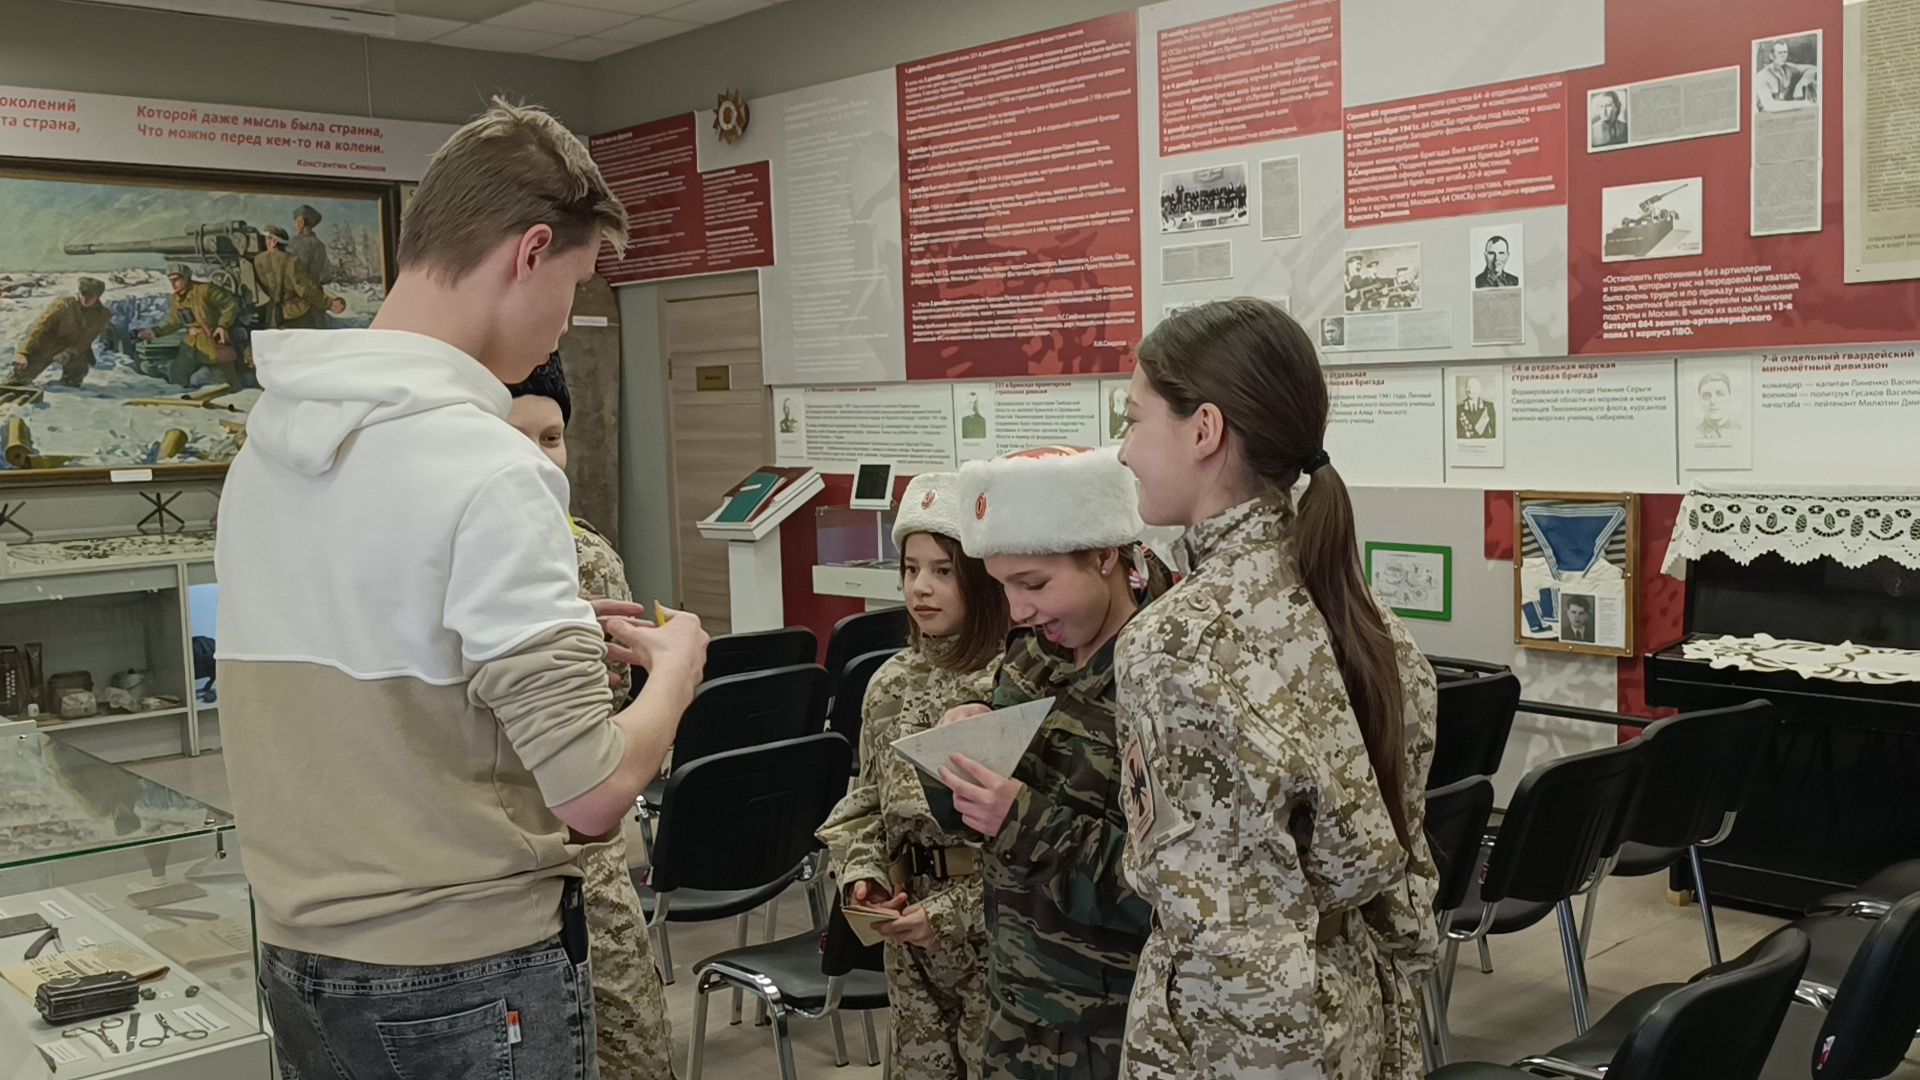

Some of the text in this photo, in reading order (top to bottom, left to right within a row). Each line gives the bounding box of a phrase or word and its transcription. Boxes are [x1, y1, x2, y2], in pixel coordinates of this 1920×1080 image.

[1446, 95, 1472, 105] состава
[1491, 86, 1529, 99] отдельной
[1530, 80, 1563, 93] морской
[0, 98, 76, 112] околений
[1488, 112, 1501, 120] под
[1502, 108, 1529, 117] Москву
[23, 119, 80, 134] страна,
[137, 106, 384, 139] Которой даже мысль была странна,
[137, 124, 384, 152] Что можно перед кем-то на колени.
[1420, 149, 1450, 159] бригады
[1452, 146, 1466, 154] был
[1468, 142, 1498, 152] капитан
[1516, 137, 1539, 148] ранга
[1704, 268, 1718, 276] без
[1720, 265, 1771, 277] артиллерии
[1705, 275, 1751, 287] передовой
[1765, 273, 1801, 281] хватало,
[1650, 290, 1678, 300] трудно
[1699, 287, 1734, 297] приказу
[1735, 282, 1799, 293] командования
[1665, 298, 1698, 308] батарей
[1753, 293, 1793, 302] ближние
[1727, 305, 1763, 314] входила
[1636, 330, 1671, 339] корпуса
[1672, 328, 1694, 336] ПВО.
[1762, 350, 1915, 363] 7-й отдельный гвардейский
[1531, 364, 1576, 373] отдельная
[1578, 362, 1616, 371] морская
[1833, 362, 1889, 372] дивизион
[1355, 379, 1385, 387] бригада
[1511, 372, 1598, 382] стрелковая бригада
[1851, 390, 1884, 398] Гусаков
